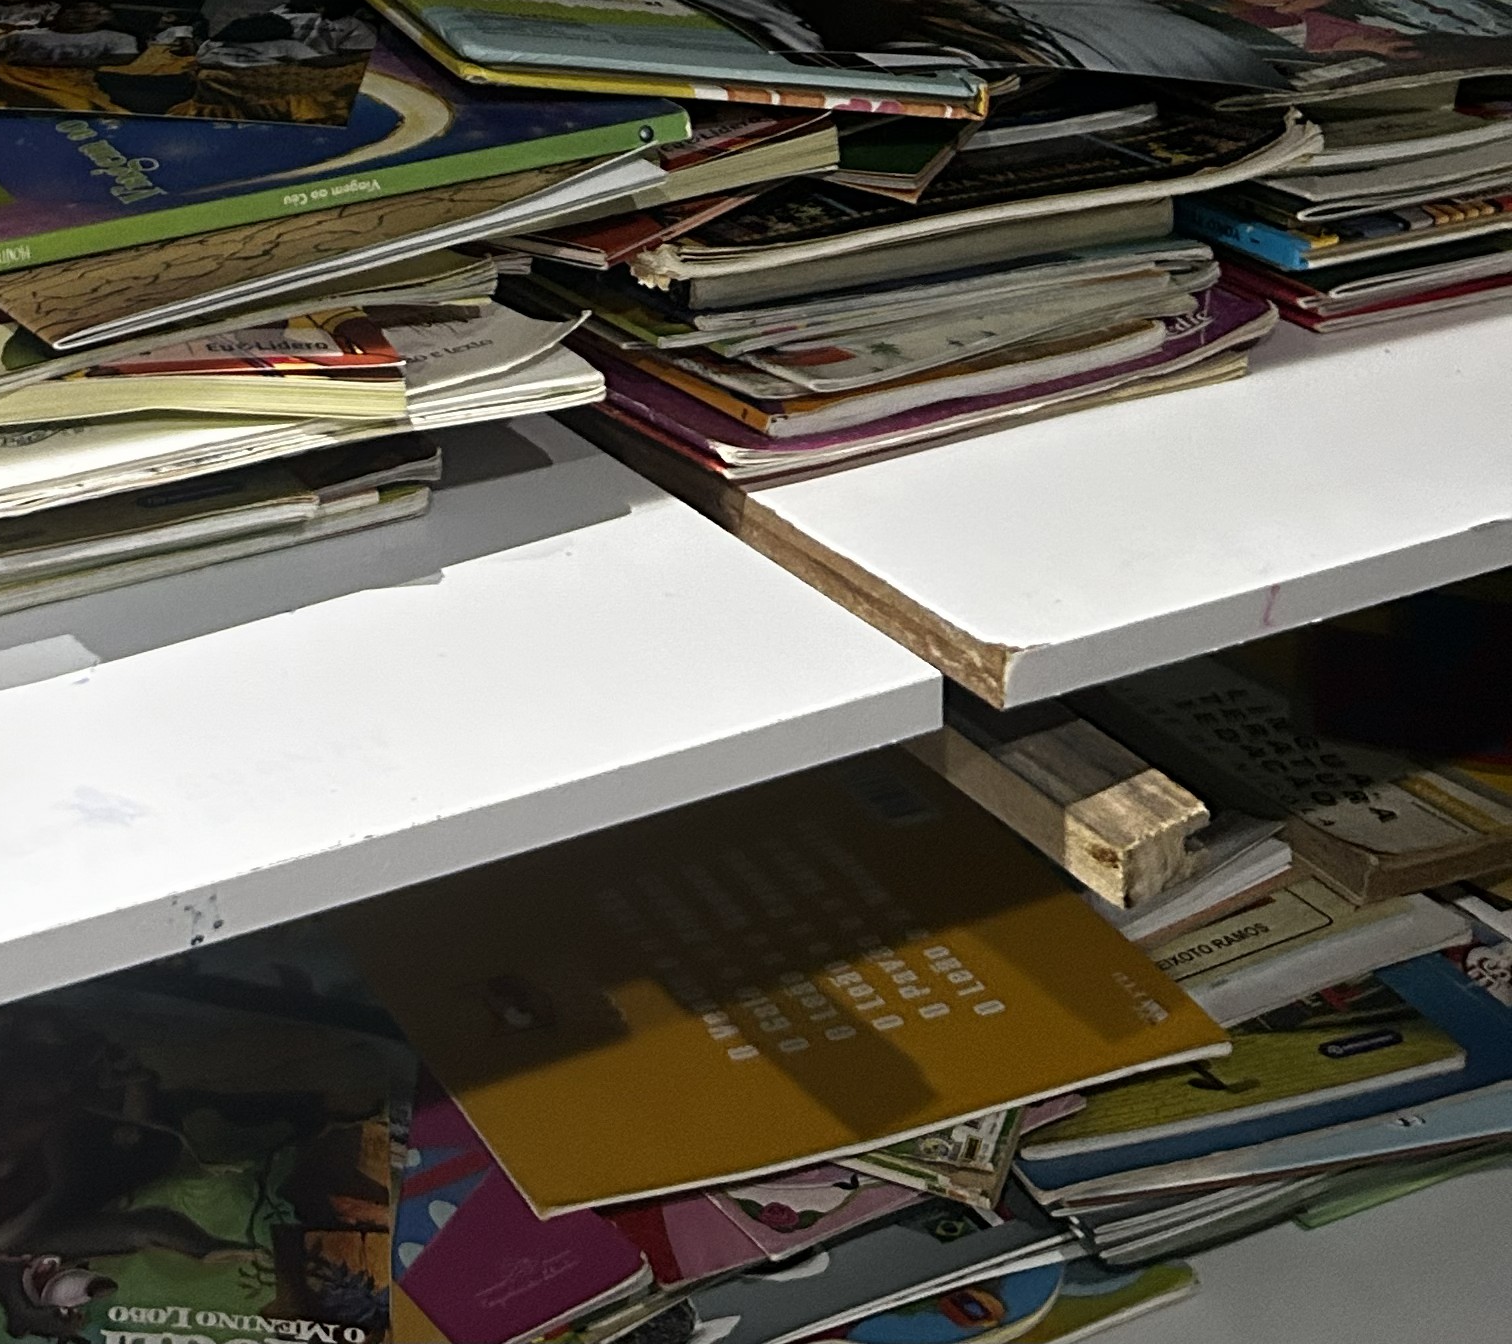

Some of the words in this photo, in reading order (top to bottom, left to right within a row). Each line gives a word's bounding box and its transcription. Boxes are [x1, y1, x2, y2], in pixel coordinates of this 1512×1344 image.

[310, 186, 330, 201] ao
[332, 178, 381, 198] Viagem
[1152, 943, 1214, 972] EIXOTO
[1212, 922, 1270, 951] RAMOS
[918, 1002, 951, 1020] O
[973, 999, 1006, 1017] O
[872, 1014, 904, 1031] O
[106, 1304, 193, 1328] LOBO
[195, 1310, 337, 1342] MENINO
[342, 1327, 365, 1343] O
